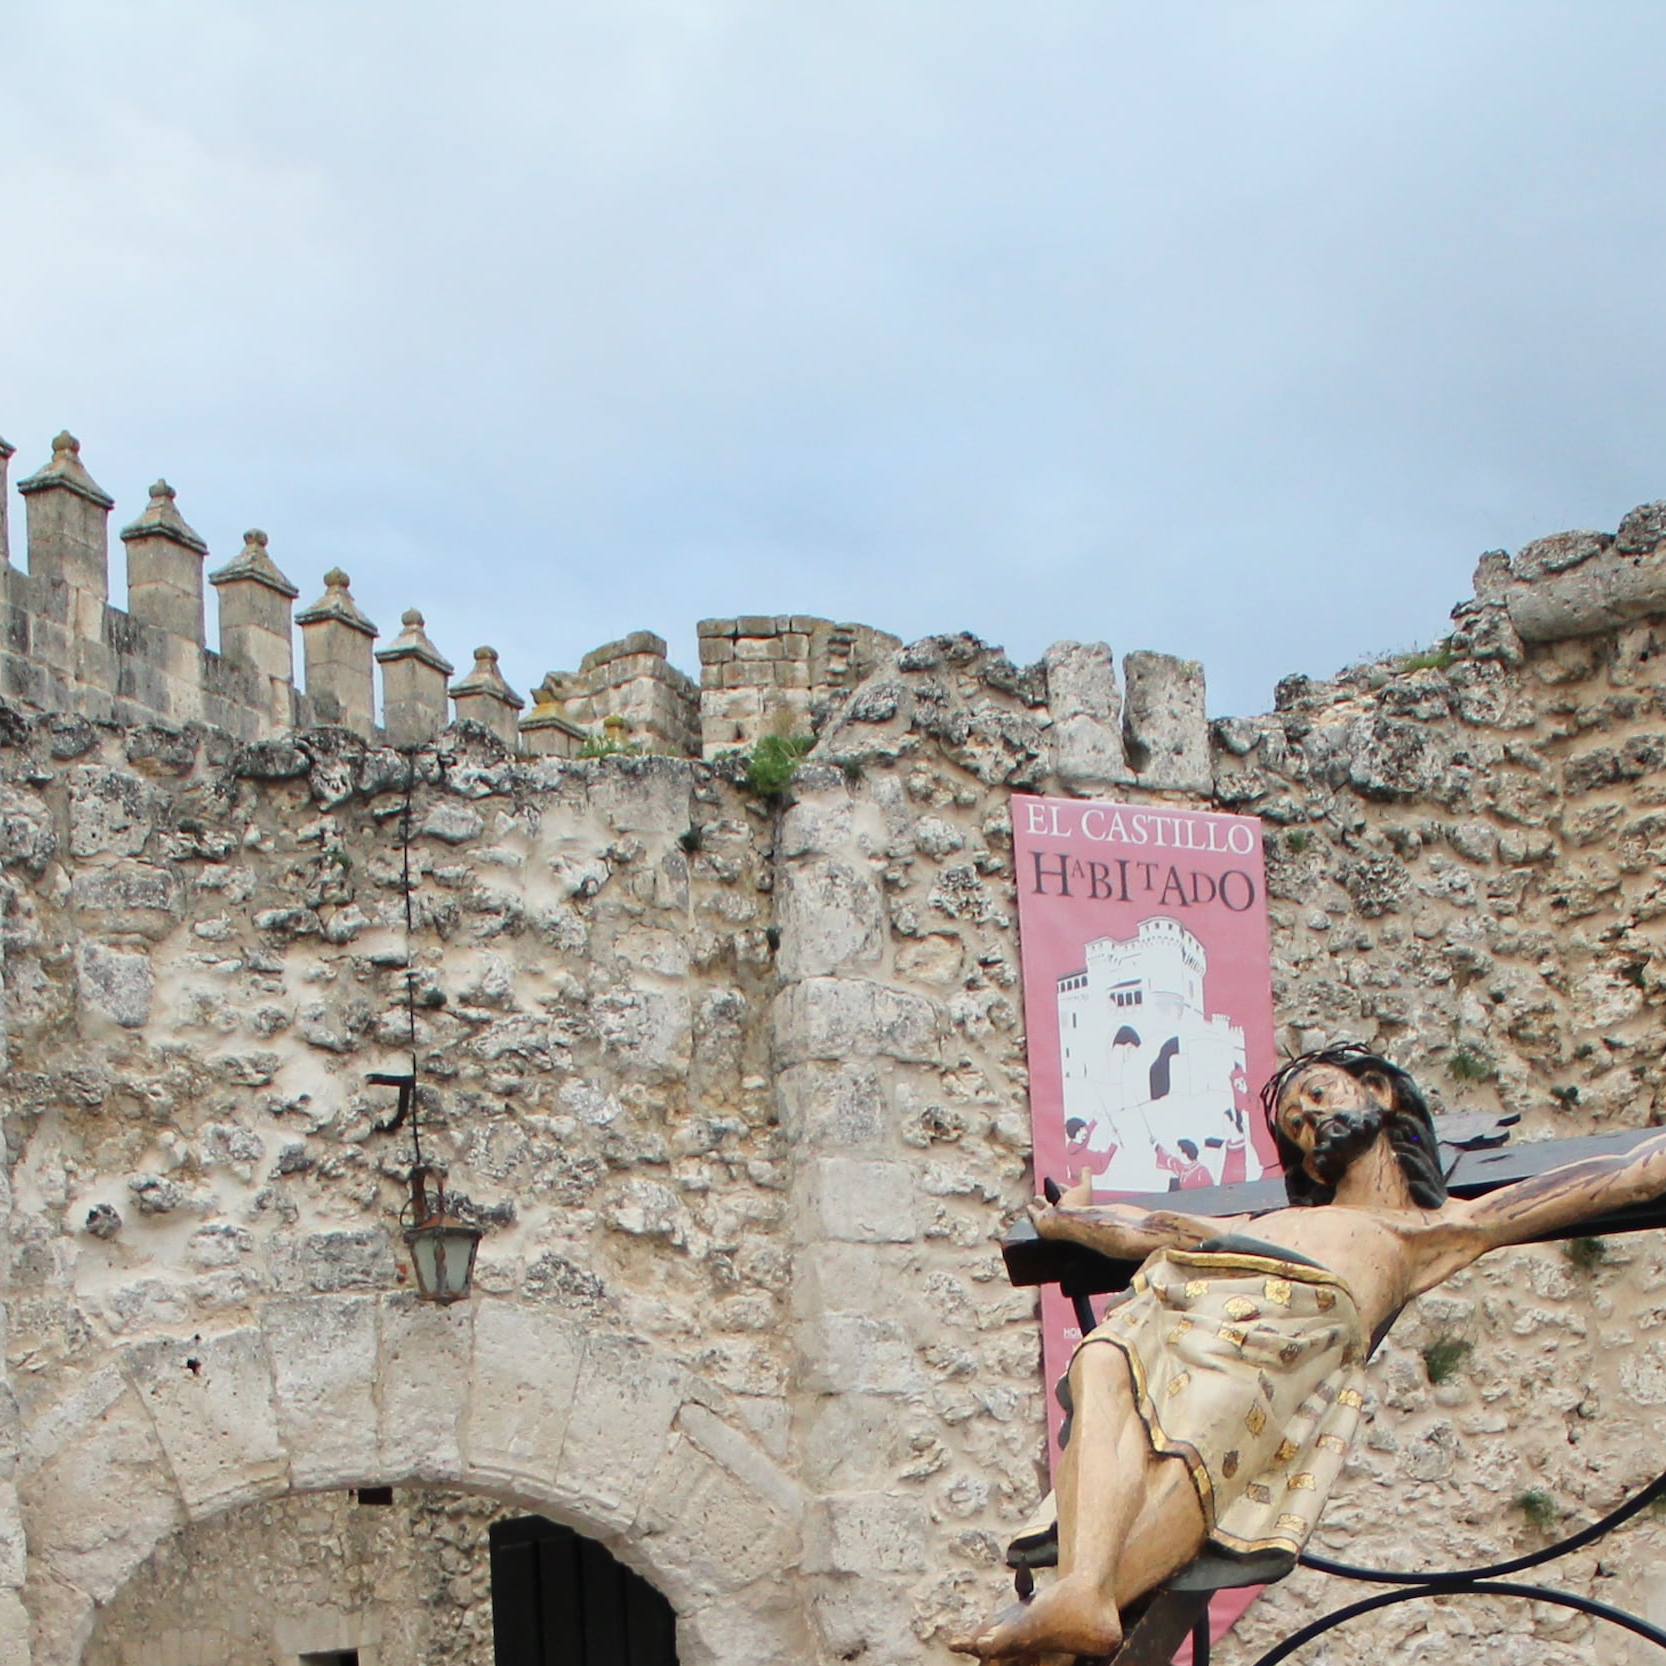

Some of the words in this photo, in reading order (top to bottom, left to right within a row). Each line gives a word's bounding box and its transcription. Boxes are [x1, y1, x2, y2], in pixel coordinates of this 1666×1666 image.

[1025, 803, 1072, 838] EL
[1081, 809, 1255, 855] CASTILLO
[1028, 850, 1256, 912] HABITADO
